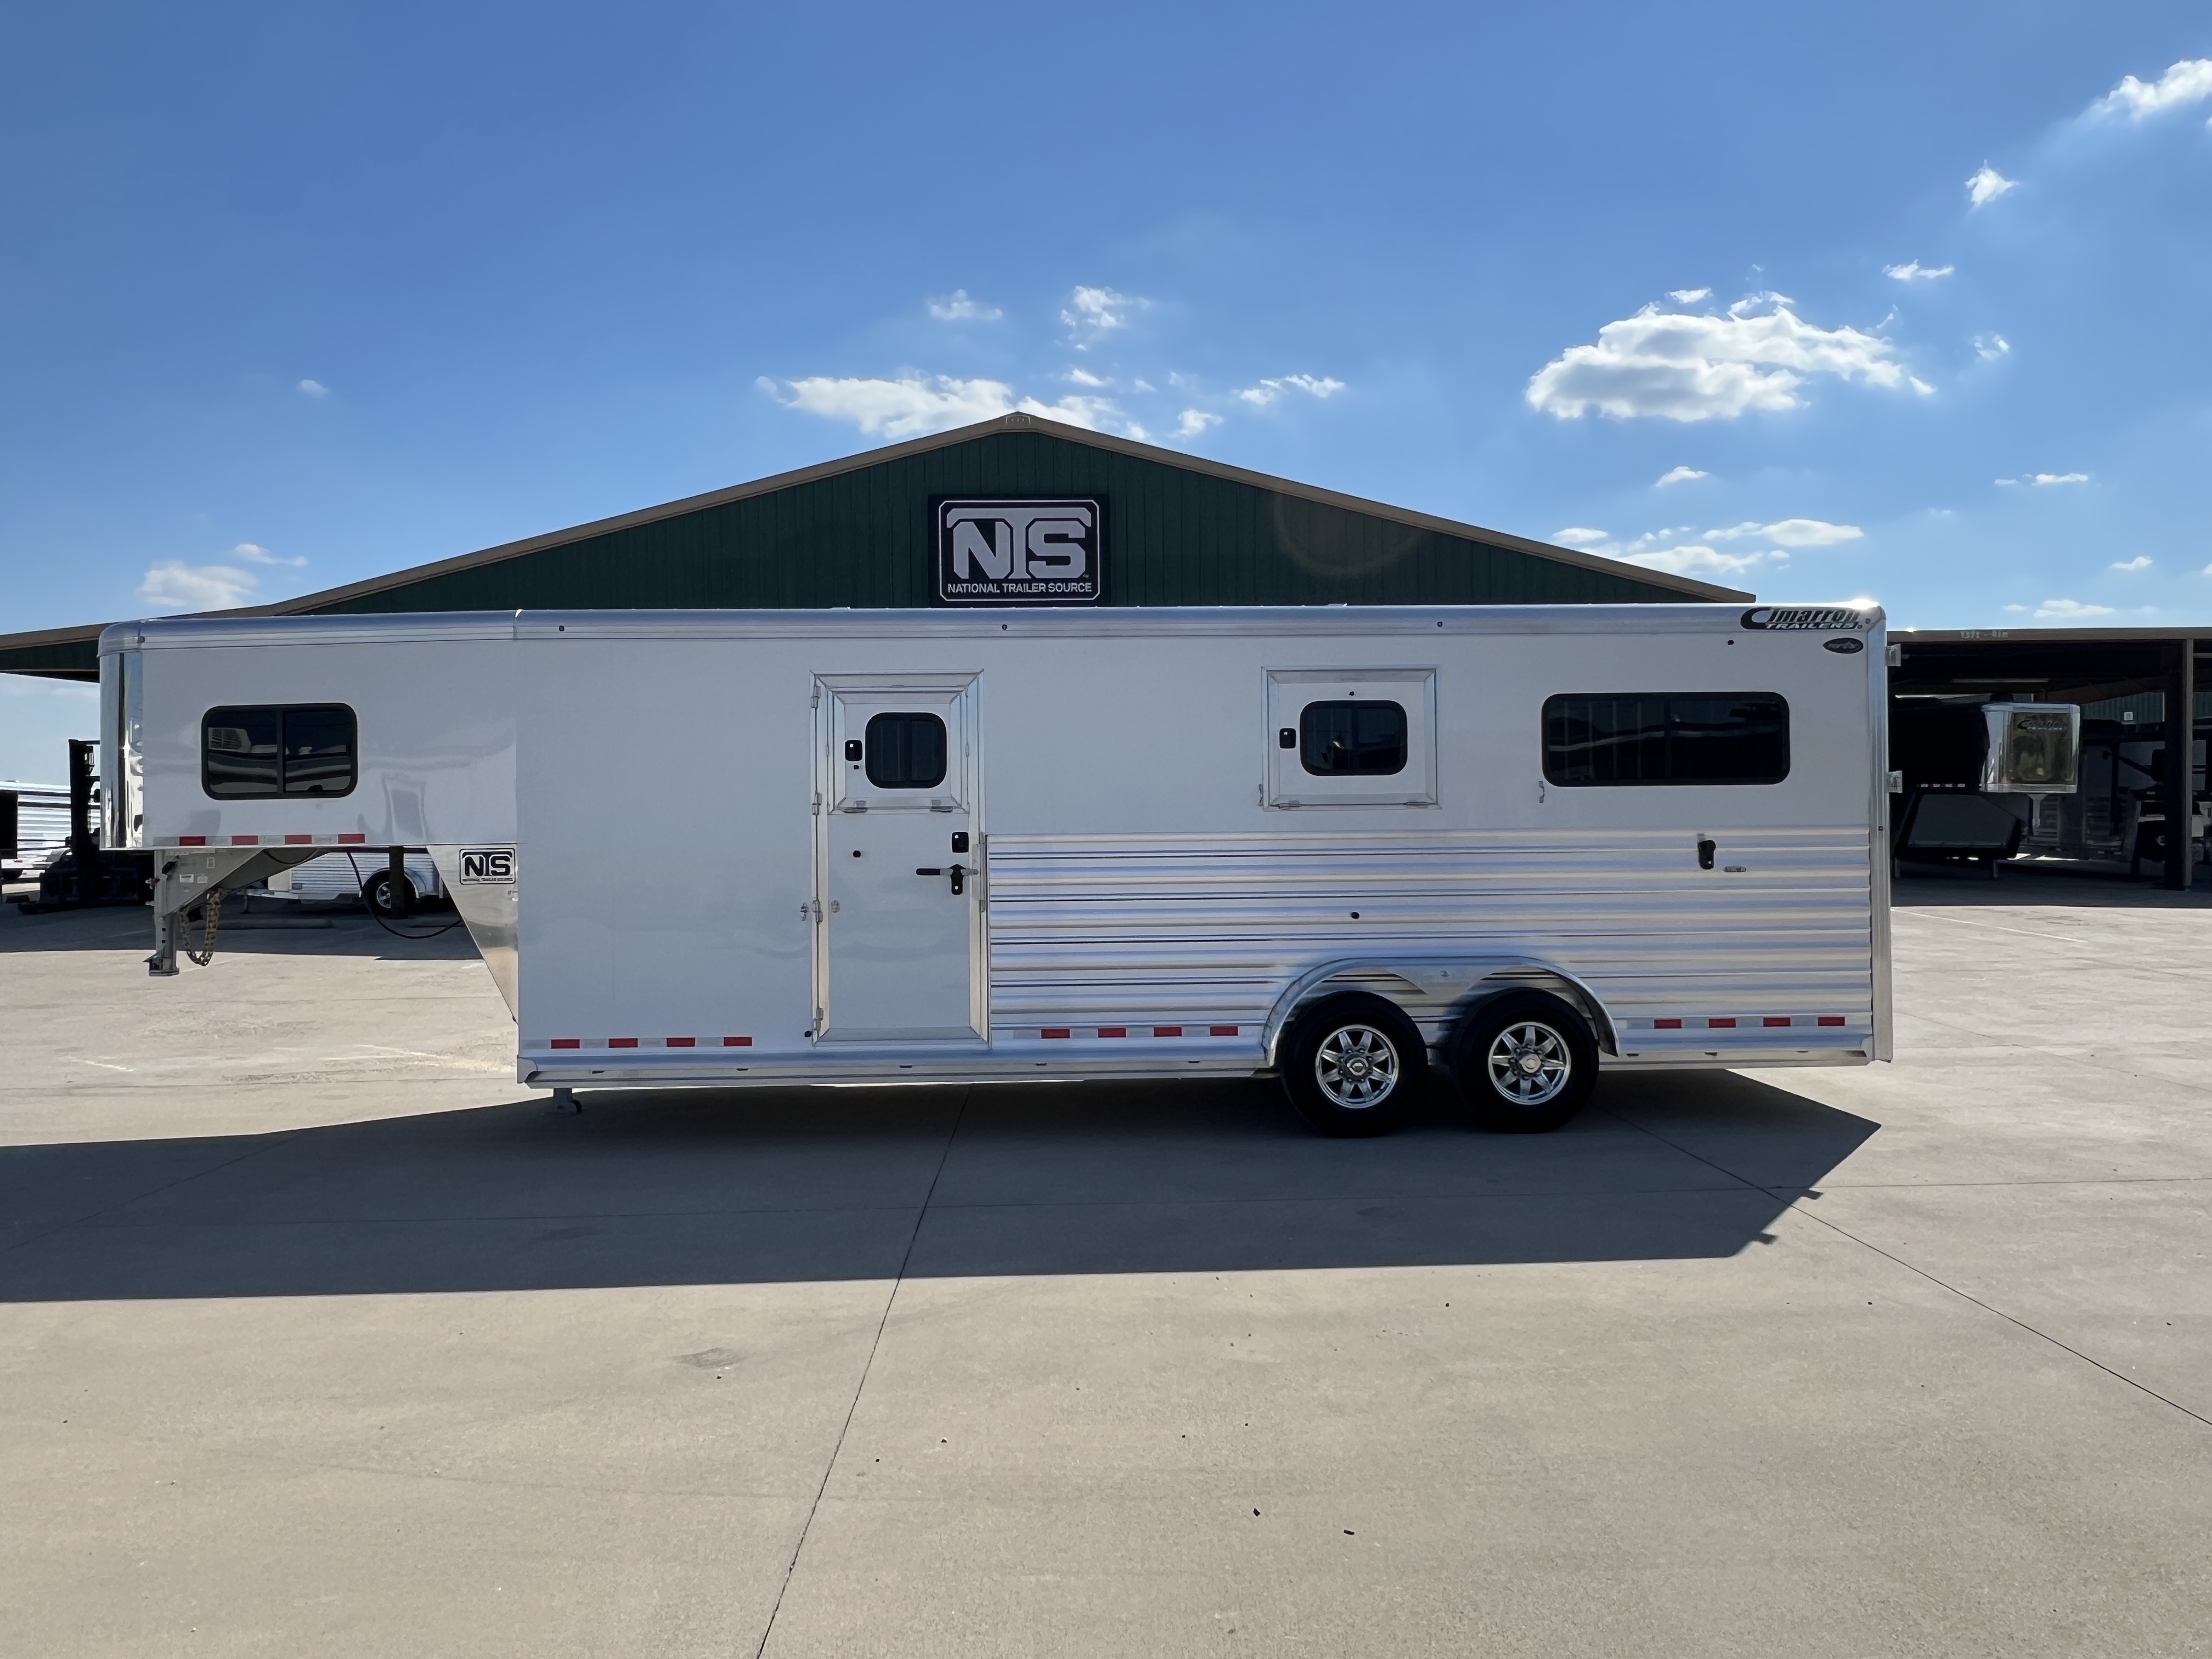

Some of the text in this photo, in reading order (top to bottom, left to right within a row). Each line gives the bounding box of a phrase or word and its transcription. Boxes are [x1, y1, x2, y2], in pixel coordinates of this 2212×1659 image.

[947, 507, 1092, 579] NTS
[947, 582, 1092, 593] NATIONAL TRAILER SOURCE
[462, 851, 512, 877] NTS
